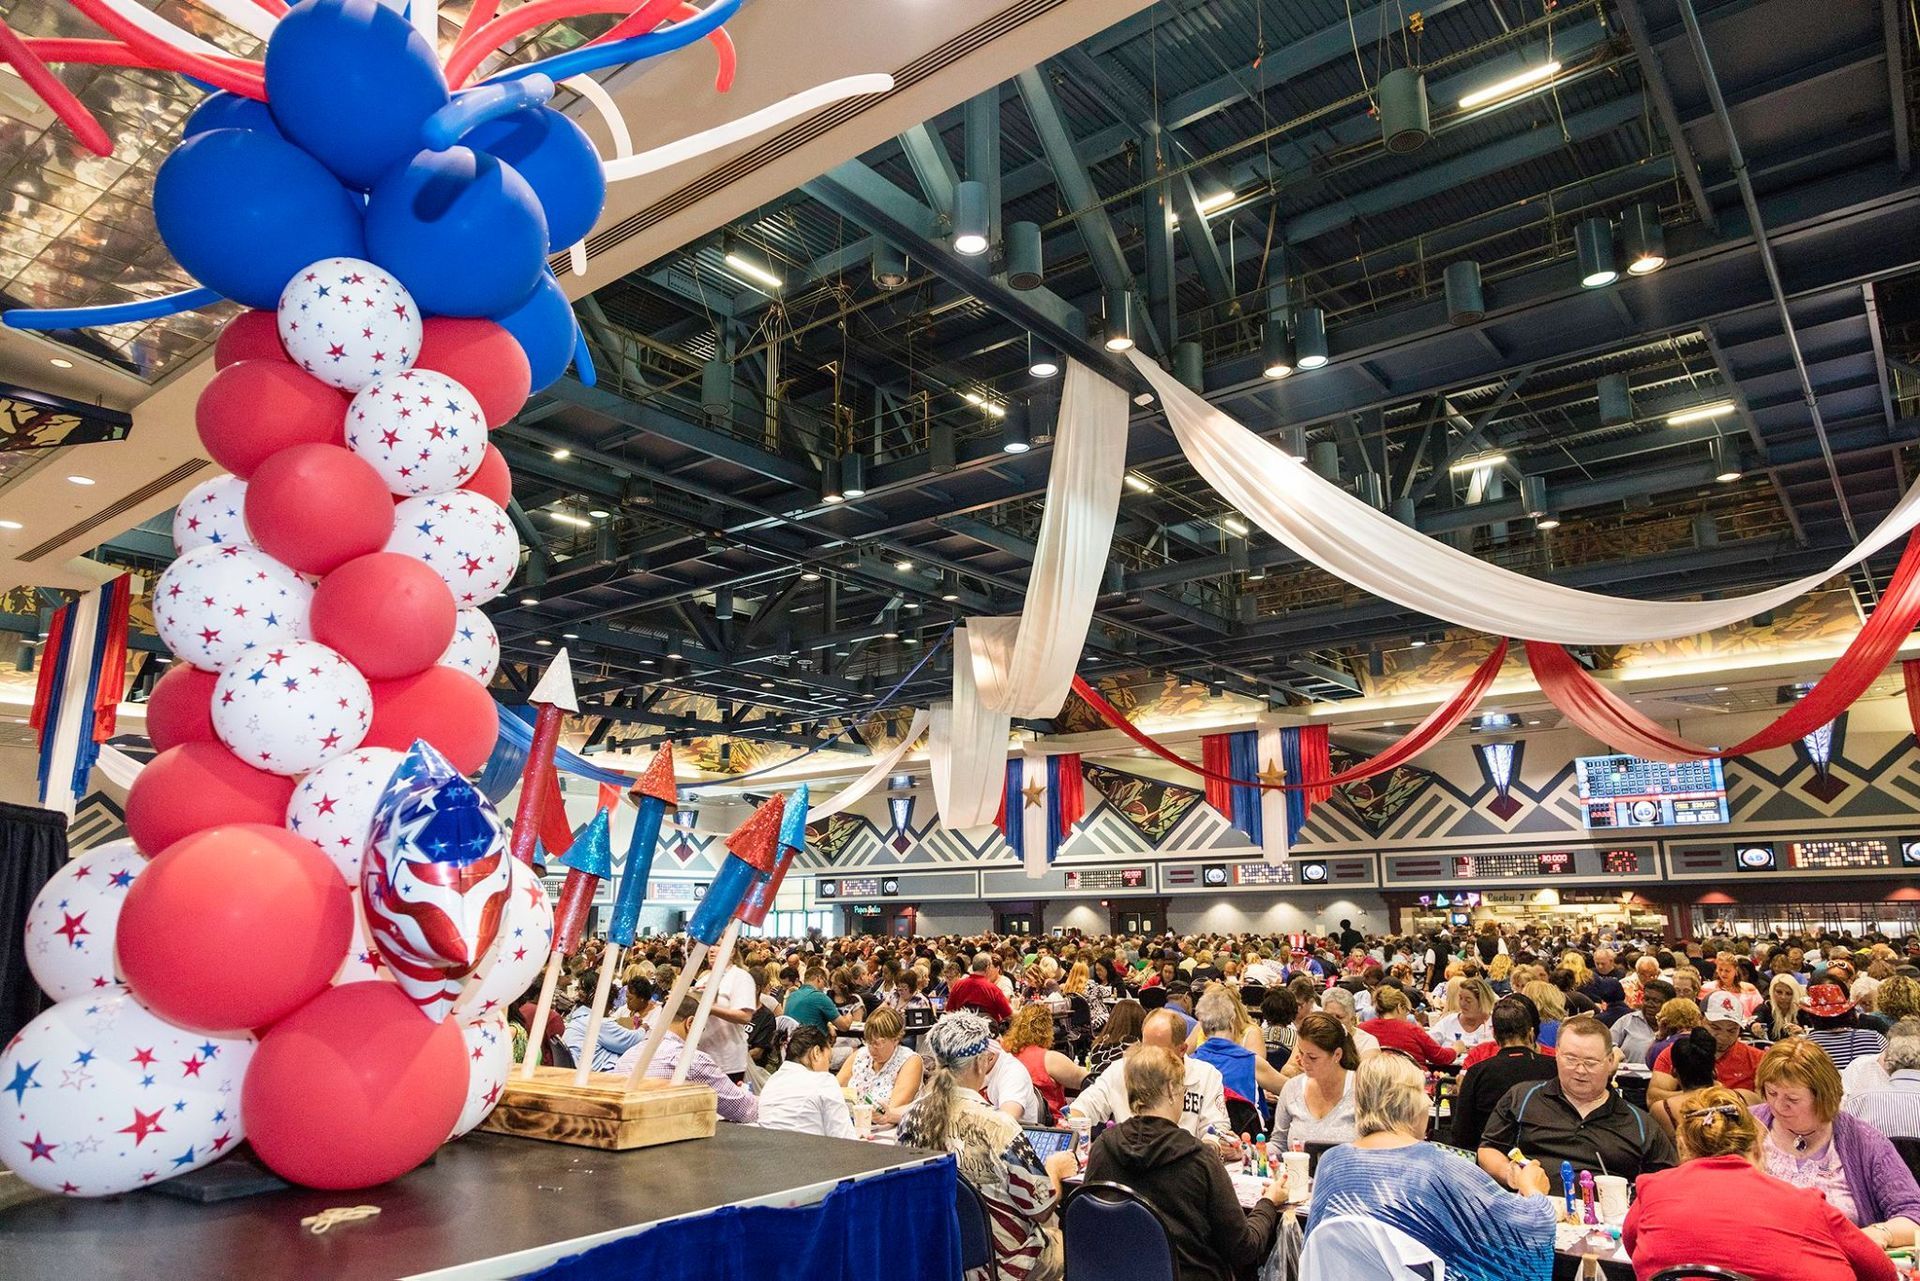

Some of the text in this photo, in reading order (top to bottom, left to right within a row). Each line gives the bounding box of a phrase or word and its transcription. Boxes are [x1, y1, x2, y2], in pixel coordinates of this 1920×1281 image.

[1637, 807, 1652, 816] 45
[1487, 893, 1515, 905] Lucky
[1519, 893, 1525, 902] 7
